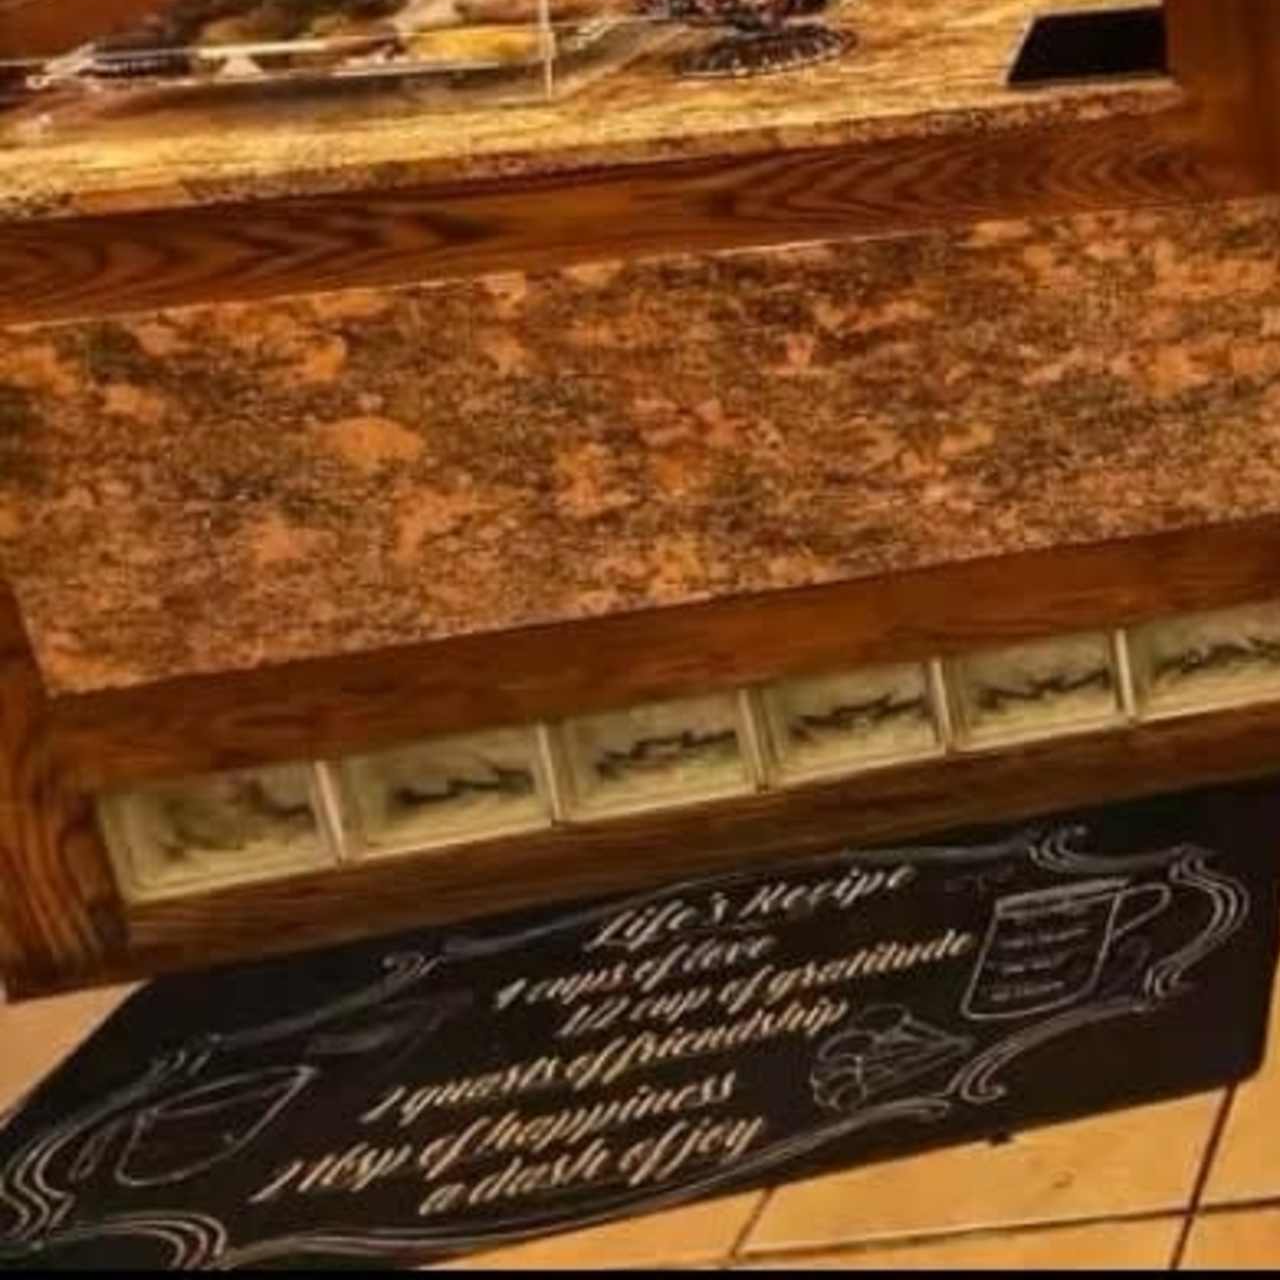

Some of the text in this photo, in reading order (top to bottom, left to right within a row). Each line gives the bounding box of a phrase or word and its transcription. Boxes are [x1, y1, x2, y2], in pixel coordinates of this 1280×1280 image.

[739, 866, 915, 916] Recipe
[524, 960, 631, 1004] cups
[632, 942, 688, 991] of
[682, 932, 776, 970] love
[630, 983, 710, 1022] cup
[717, 964, 775, 1013] of
[765, 928, 974, 1002] gratitude
[401, 1055, 557, 1122] quarts
[564, 1034, 625, 1090] of
[600, 999, 850, 1084] friendship
[419, 1118, 480, 1180] of
[475, 1068, 738, 1152] happiness
[419, 1114, 764, 1216] a dash of joy
